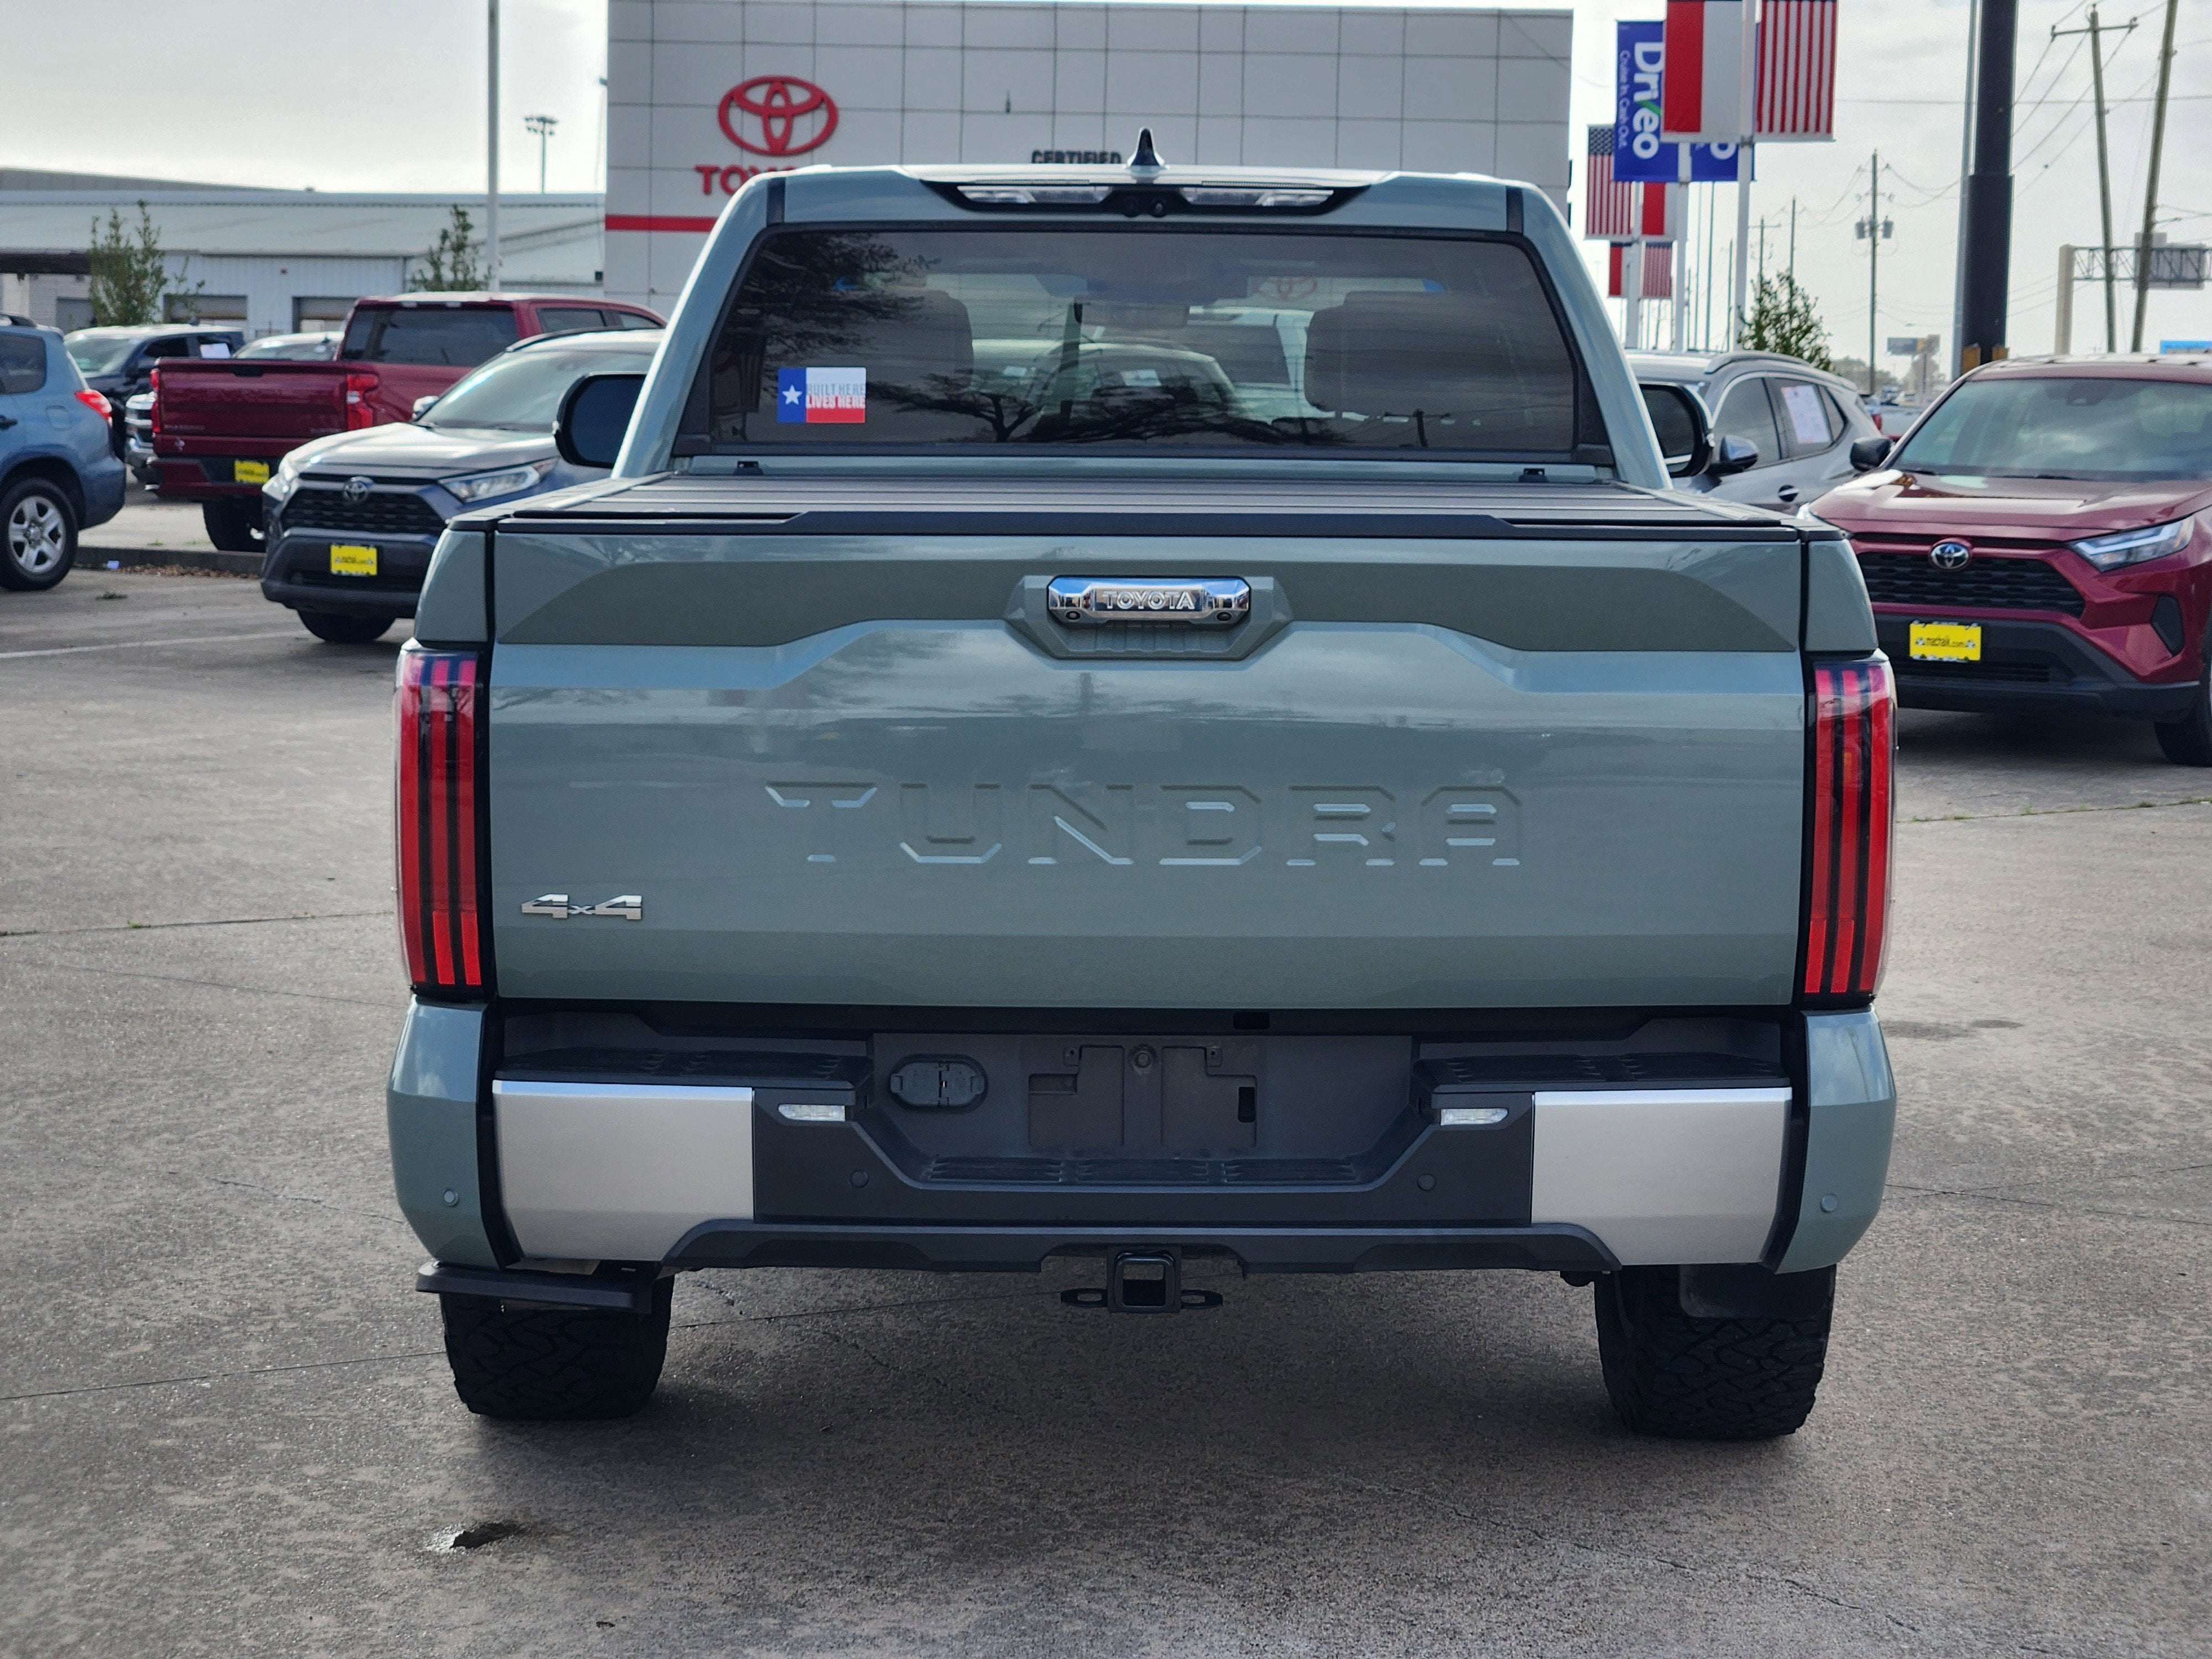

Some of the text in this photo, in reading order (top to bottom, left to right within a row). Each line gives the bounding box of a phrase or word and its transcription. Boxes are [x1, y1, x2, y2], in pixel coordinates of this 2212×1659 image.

[806, 383, 866, 395] BUILT HERE
[806, 395, 866, 409] LIVES HERE
[1103, 590, 1194, 609] TOYOTA
[765, 781, 1521, 866] TUNDRA
[521, 894, 642, 920] 4x4
